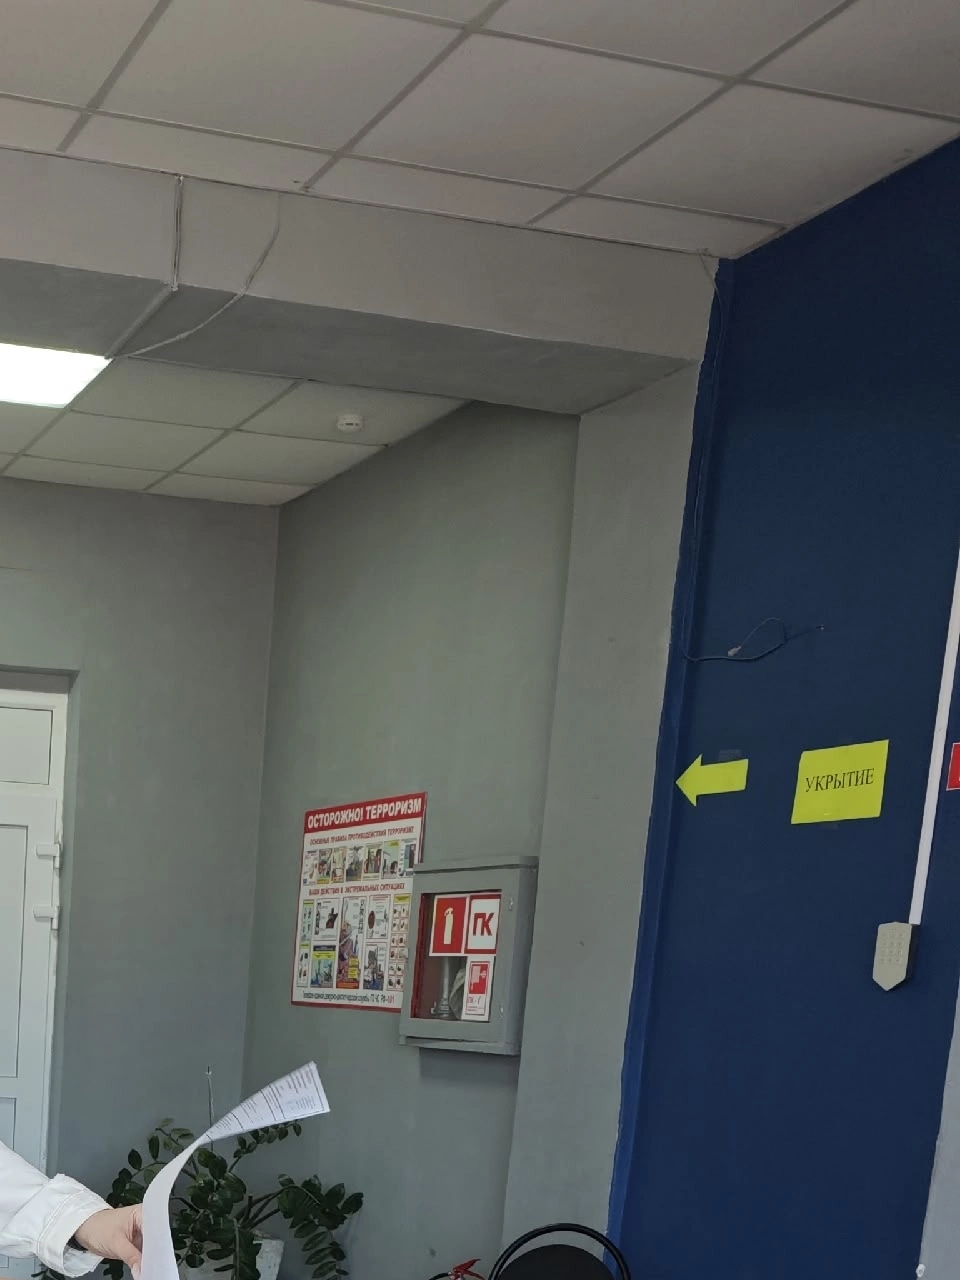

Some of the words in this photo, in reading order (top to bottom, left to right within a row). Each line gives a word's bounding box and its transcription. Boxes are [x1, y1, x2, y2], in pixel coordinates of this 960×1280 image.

[805, 768, 874, 792] УКРЫТИЕ
[307, 807, 363, 829] ОСТОРОЖНО!
[365, 798, 422, 820] ТЕРРОРИЗМ
[472, 912, 495, 937] ПК
